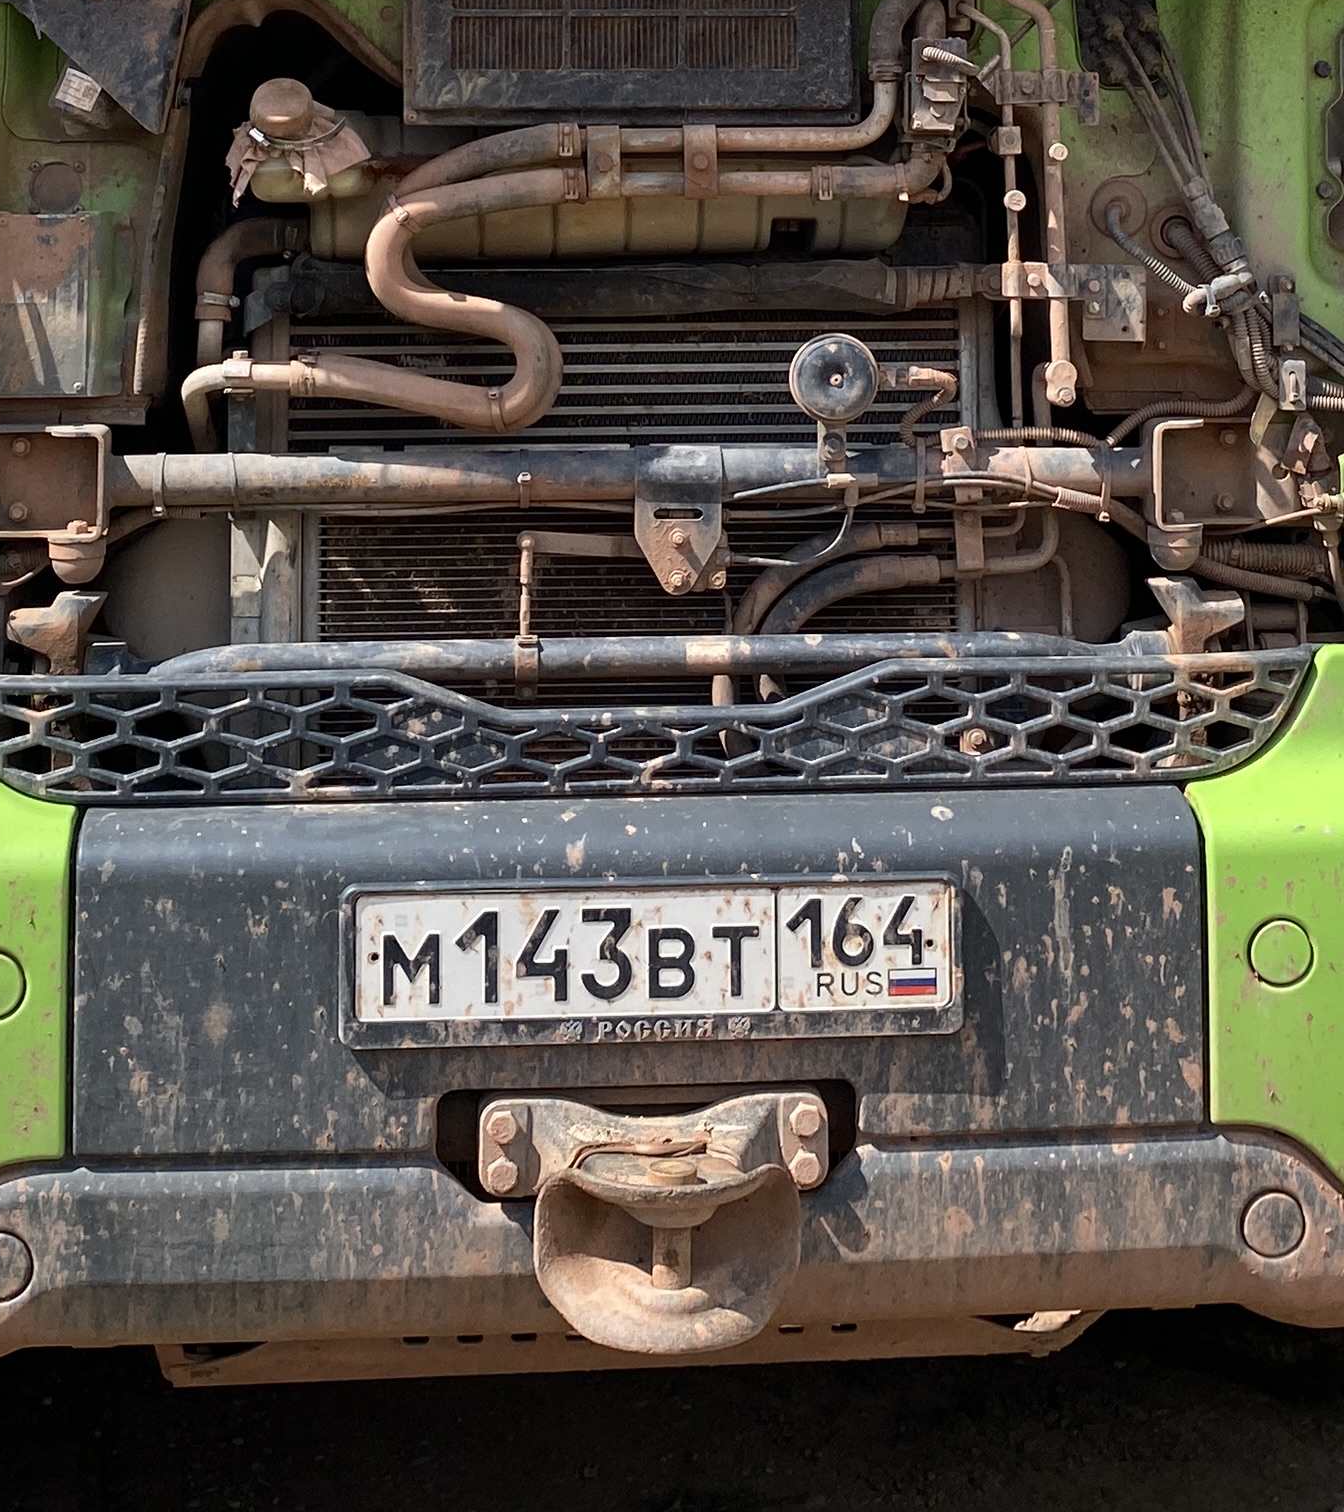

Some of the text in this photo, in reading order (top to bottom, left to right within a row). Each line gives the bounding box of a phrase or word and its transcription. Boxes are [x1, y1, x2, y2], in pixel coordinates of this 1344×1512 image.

[785, 895, 924, 969] 164
[816, 971, 885, 997] RUS
[596, 1018, 714, 1042] РОССИЯ
